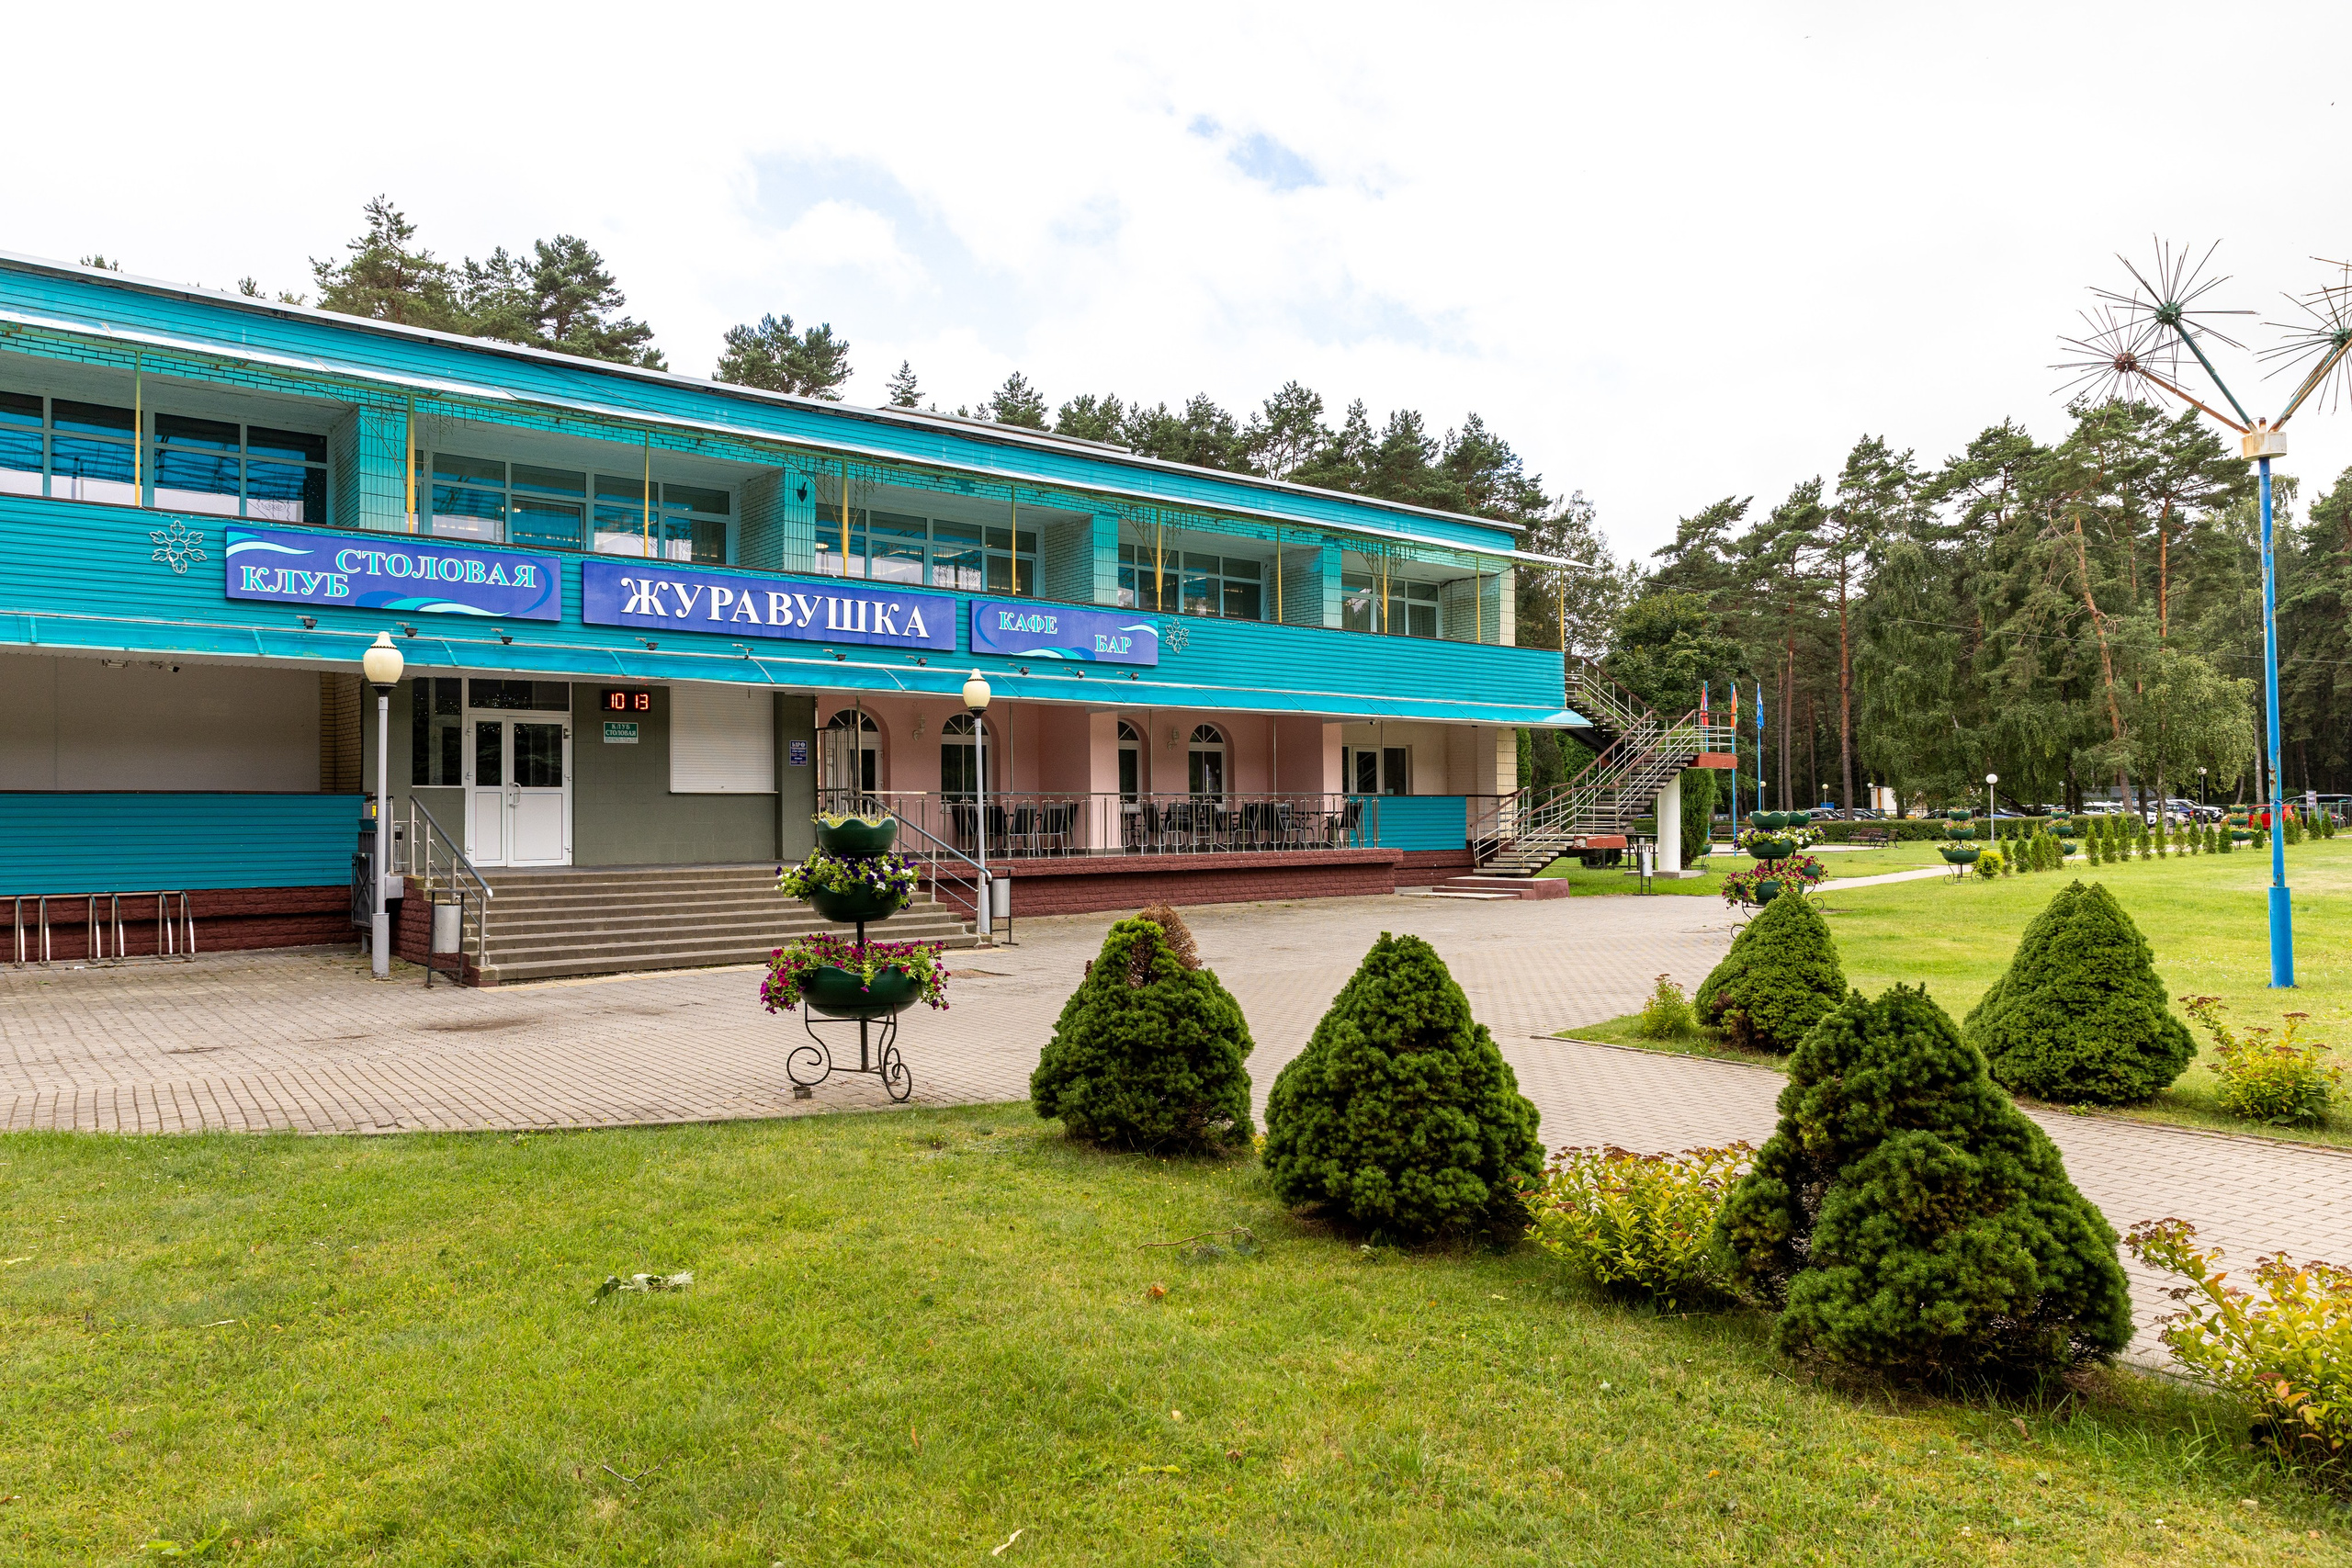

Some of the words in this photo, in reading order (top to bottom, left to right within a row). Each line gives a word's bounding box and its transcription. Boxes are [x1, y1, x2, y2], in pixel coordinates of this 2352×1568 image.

[239, 565, 350, 598] КЛУБ
[335, 548, 537, 589] СТОЛОВАЯ
[620, 577, 931, 638] ЖУРАВУШКА
[999, 611, 1058, 634] КАФЕ
[1094, 634, 1132, 654] БАР
[611, 693, 625, 709] 10
[635, 694, 649, 710] 13
